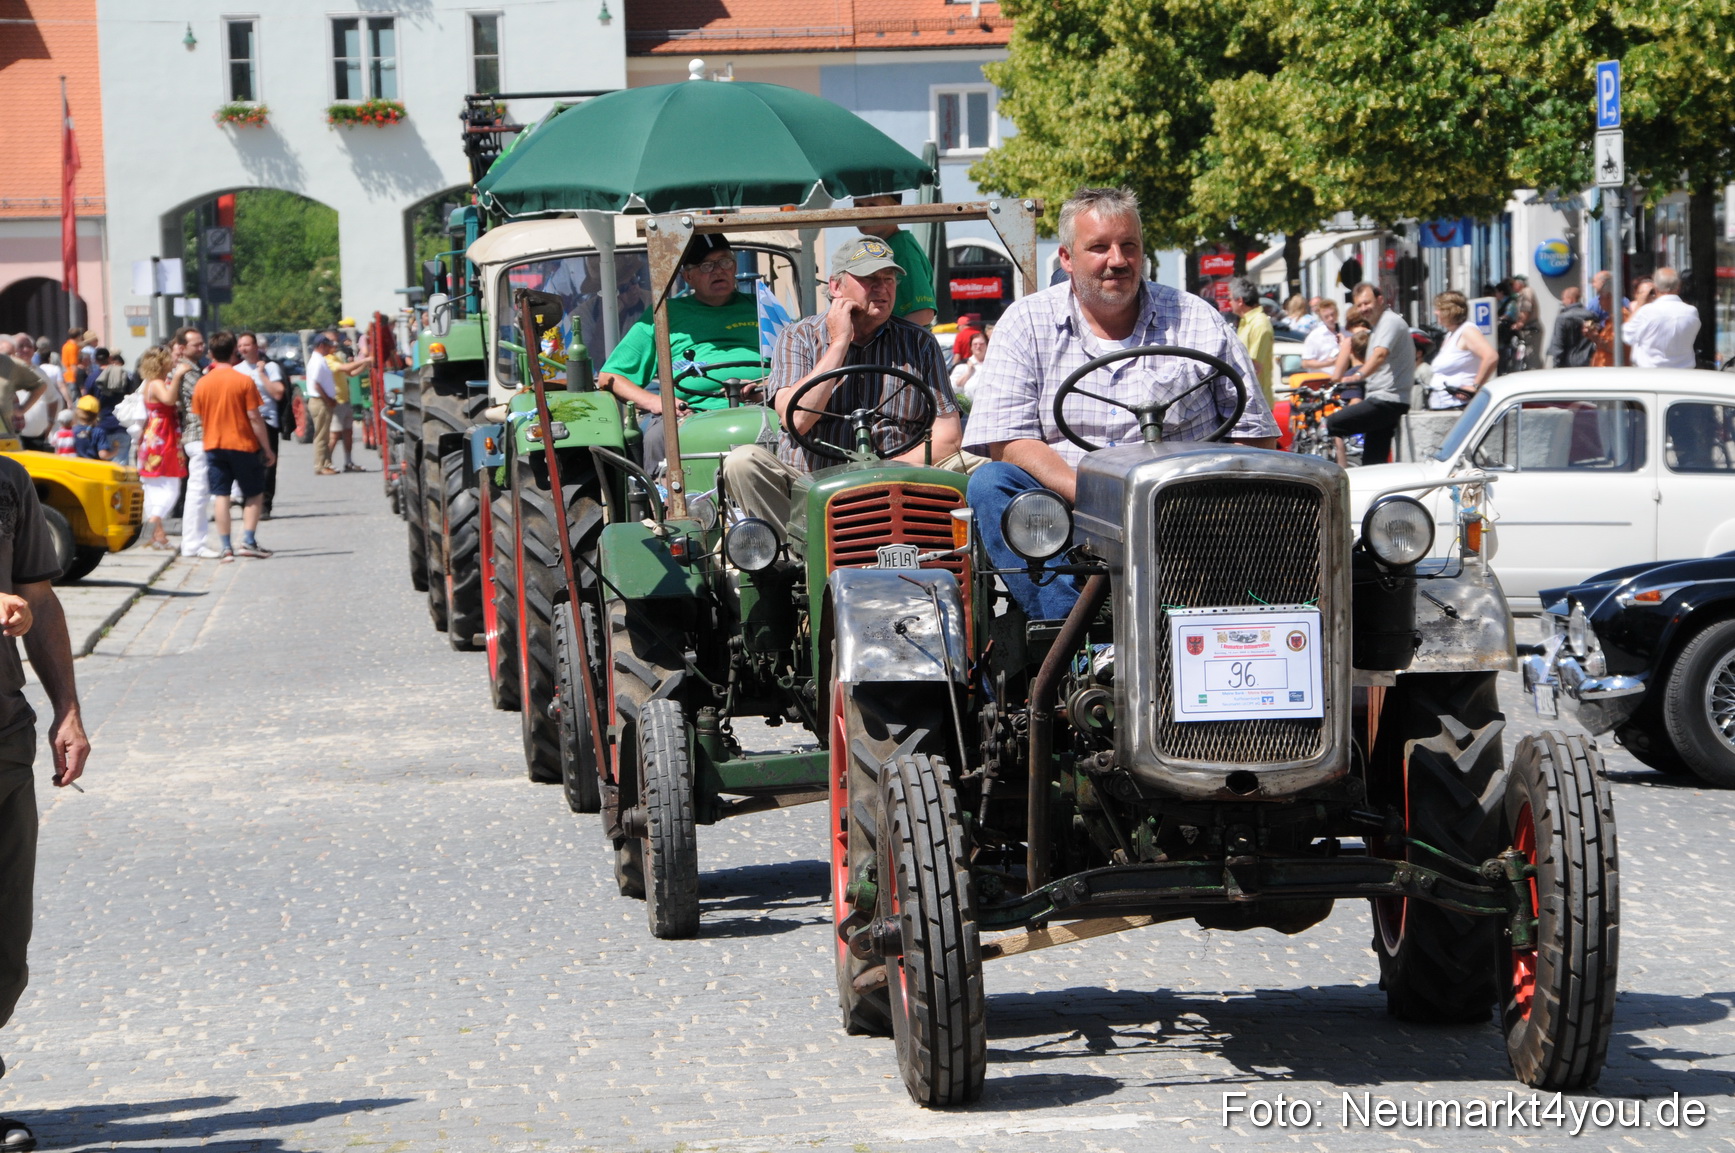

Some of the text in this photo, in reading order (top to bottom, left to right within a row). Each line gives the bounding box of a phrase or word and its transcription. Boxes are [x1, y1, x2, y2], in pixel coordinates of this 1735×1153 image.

[1601, 70, 1616, 119] P
[1539, 251, 1571, 260] Thomas
[1550, 259, 1570, 267] Cook
[1477, 305, 1489, 322] P
[884, 551, 912, 568] HELA
